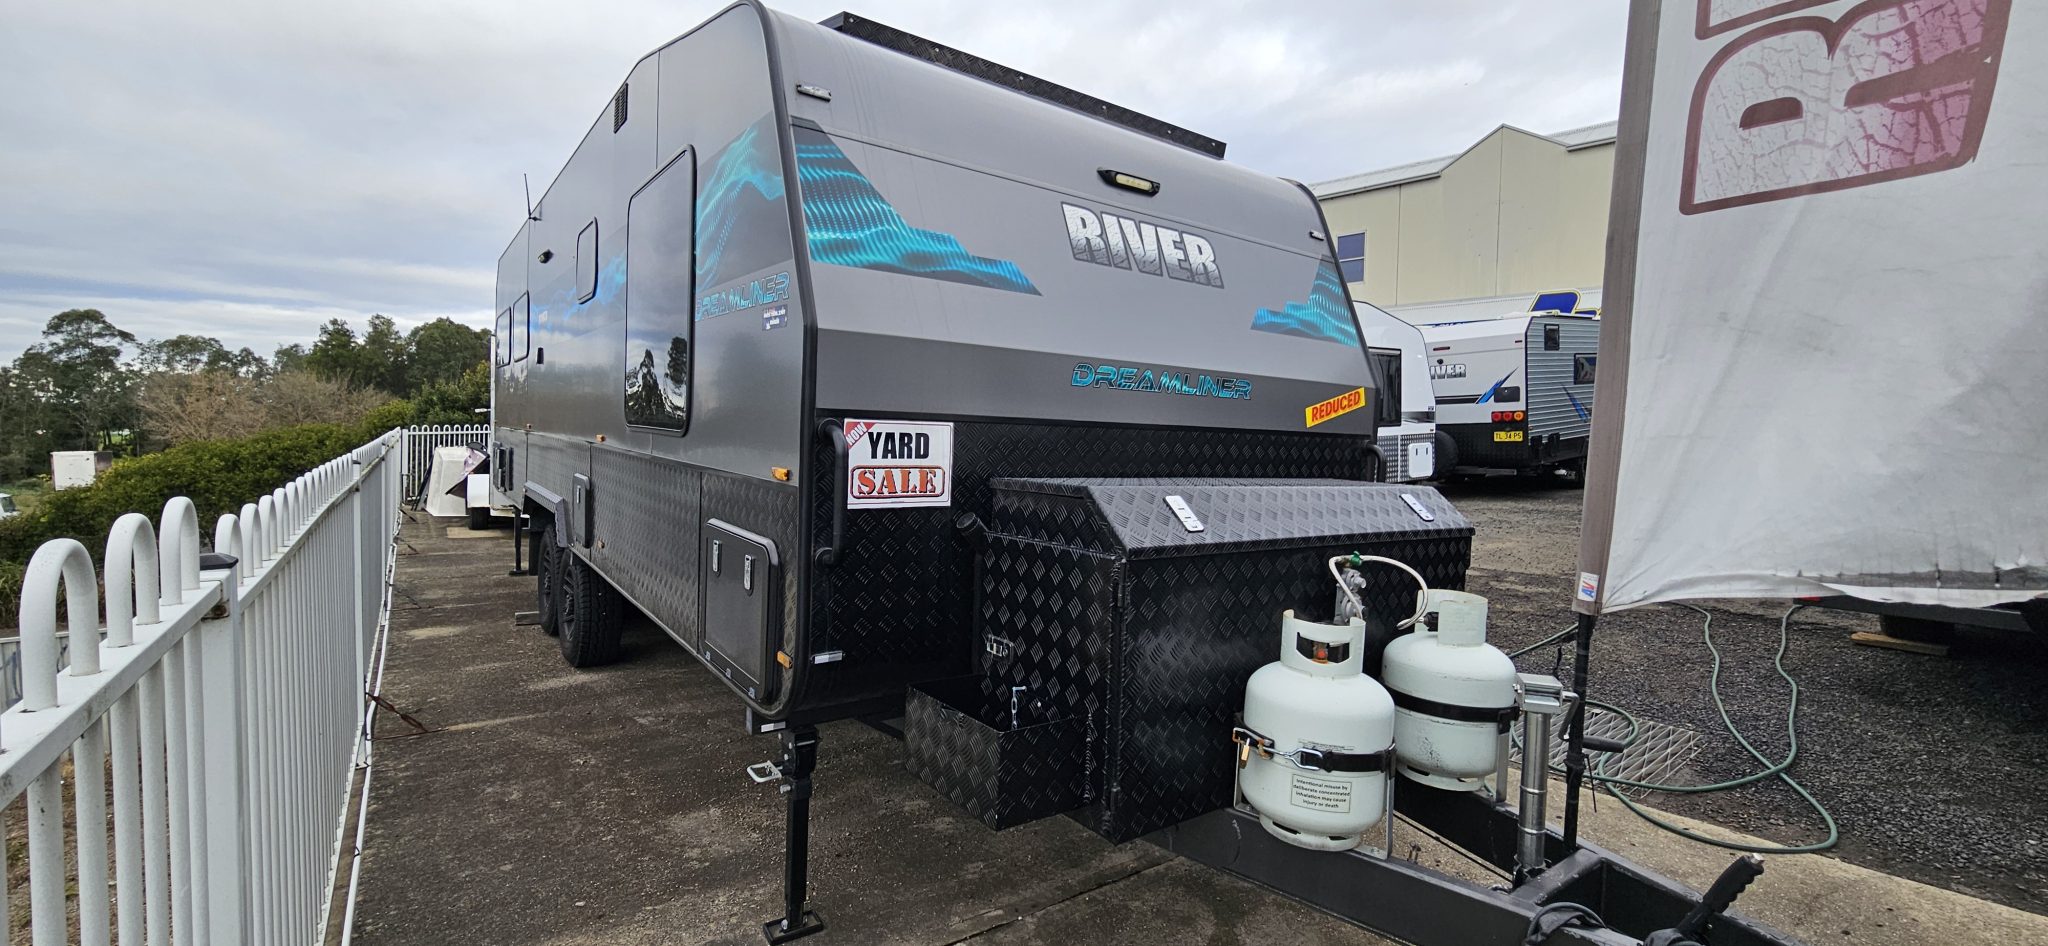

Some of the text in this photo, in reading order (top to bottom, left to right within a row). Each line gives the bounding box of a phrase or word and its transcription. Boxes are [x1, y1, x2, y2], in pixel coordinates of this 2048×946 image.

[1679, 0, 2012, 215] R
[1061, 201, 1224, 289] RIVER
[695, 272, 790, 322] DREAMLINER
[1071, 363, 1251, 400] DREAMLINER
[1429, 364, 1467, 379] IVER
[1311, 391, 1361, 422] REDUCED
[846, 422, 868, 446] NOW
[868, 431, 930, 459] YARD
[857, 468, 937, 495] SALE
[1292, 784, 1318, 793] deliberate
[1296, 778, 1323, 788] Intentional
